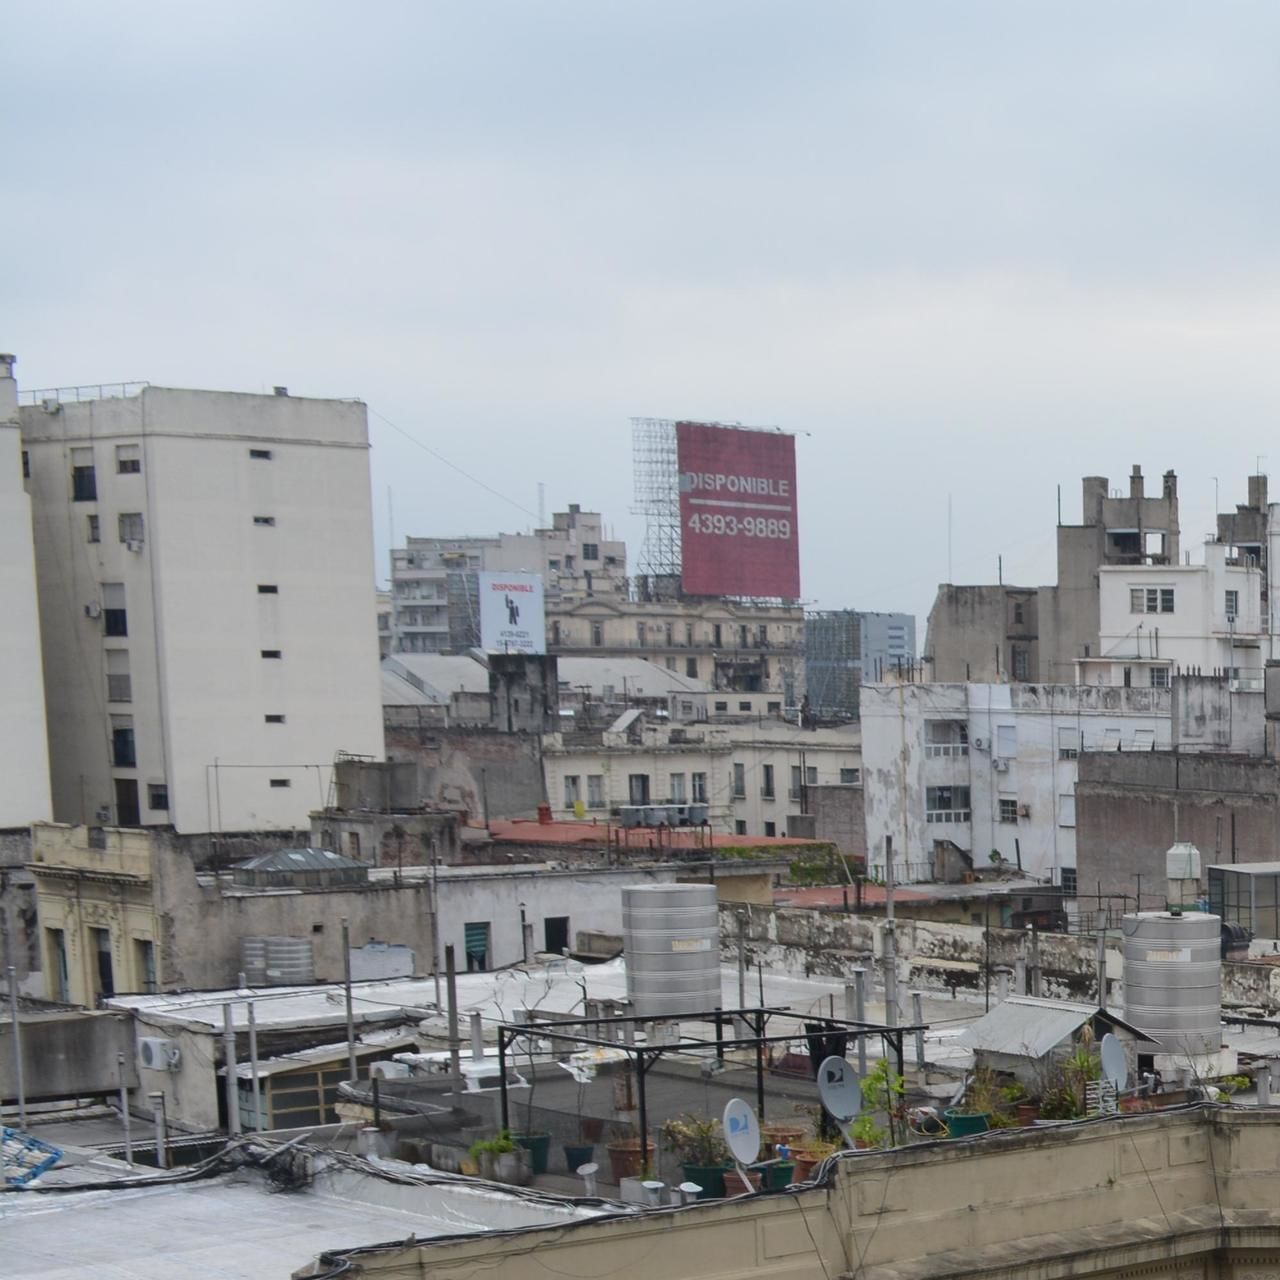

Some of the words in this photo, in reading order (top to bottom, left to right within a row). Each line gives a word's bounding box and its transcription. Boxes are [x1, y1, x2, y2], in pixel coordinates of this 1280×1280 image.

[686, 472, 790, 497] DISPONIBLE
[687, 513, 791, 539] 4393-9889
[491, 583, 535, 593] DISPONIBLE
